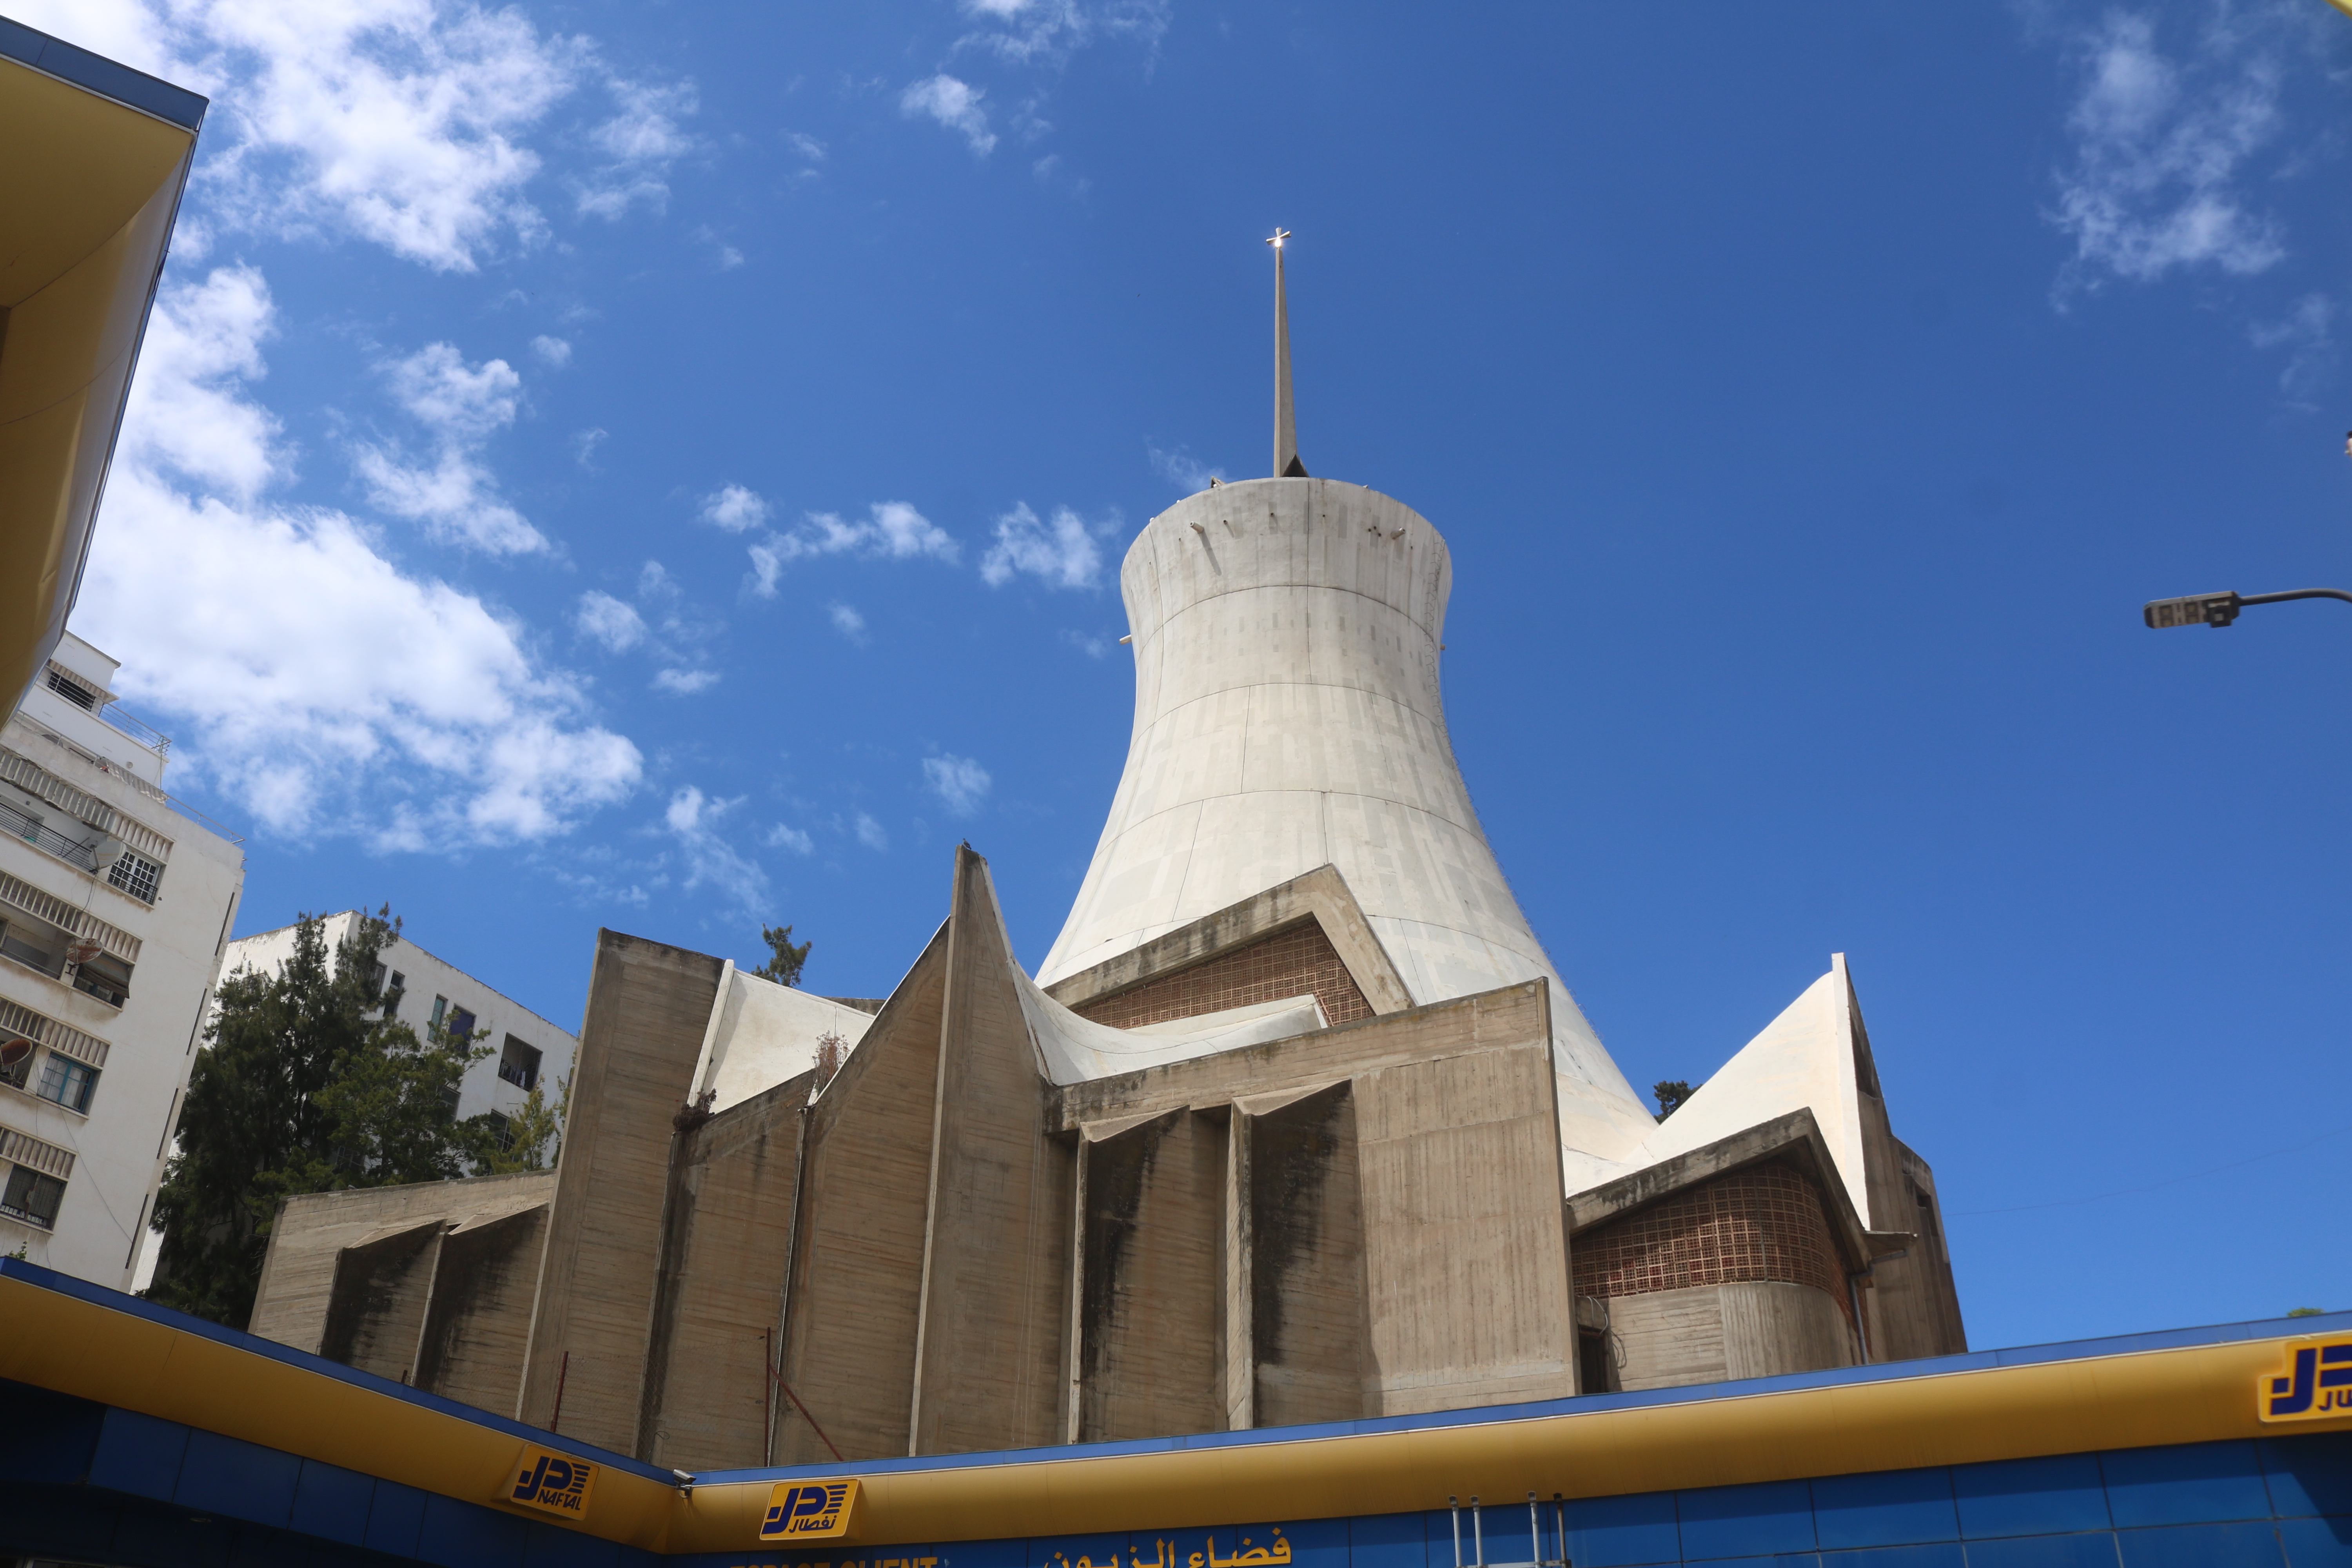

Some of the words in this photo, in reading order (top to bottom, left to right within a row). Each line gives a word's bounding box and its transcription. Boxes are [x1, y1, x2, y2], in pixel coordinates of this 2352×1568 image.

[537, 1489, 582, 1511] NAFTAL
[788, 1515, 837, 1534] نفطال
[1188, 1527, 1292, 1568] فضاء
